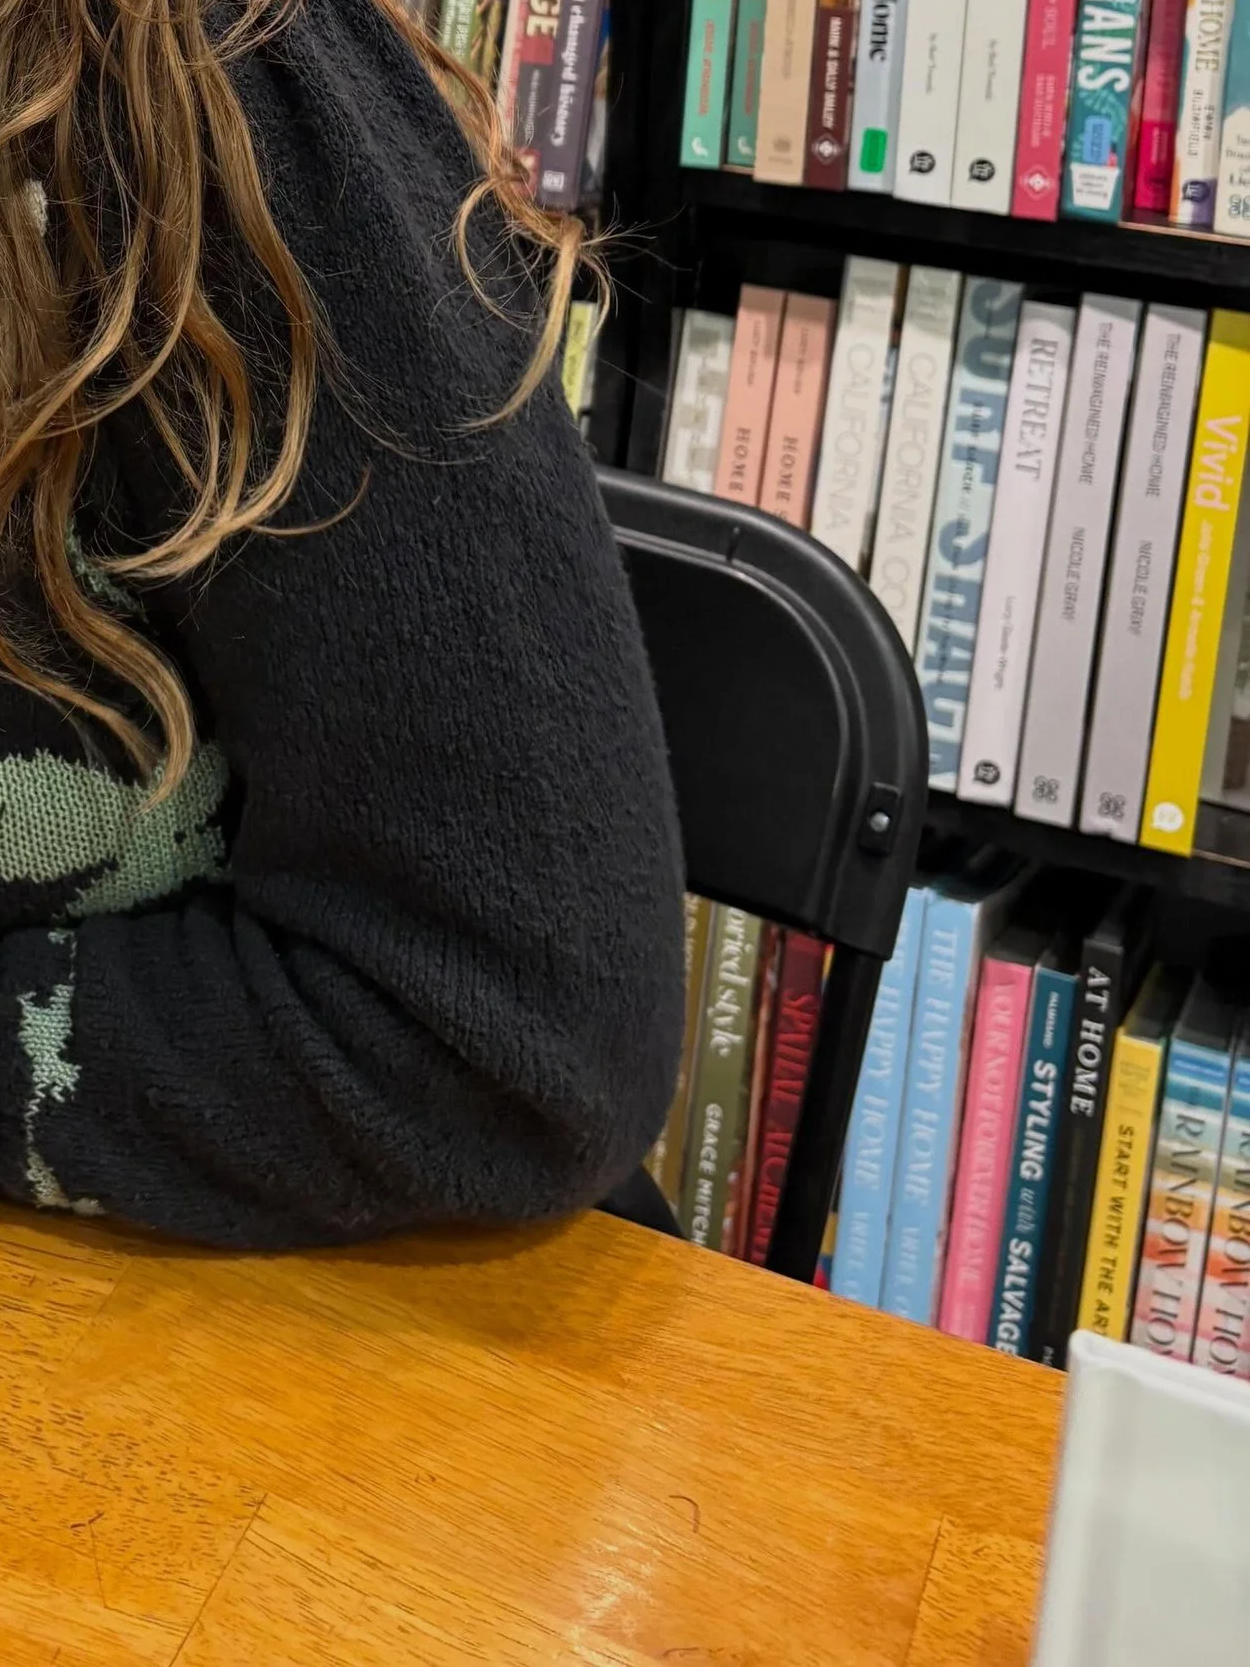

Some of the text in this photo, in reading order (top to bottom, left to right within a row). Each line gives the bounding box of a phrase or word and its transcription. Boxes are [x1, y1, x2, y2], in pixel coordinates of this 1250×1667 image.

[1194, 0, 1225, 73] HOME
[728, 427, 752, 492] HOME
[827, 342, 876, 531] CALIFORNIA
[891, 352, 938, 543] CALIFORNIA
[951, 284, 1020, 485] SURF
[1014, 337, 1060, 480] RETREAT
[1192, 415, 1243, 512] Vivid
[775, 435, 799, 502] HOME
[1062, 322, 1113, 622] THE REIMAGINED HOME NICOLE GRAY
[1127, 334, 1181, 636] THE REIMAGINED HOME NICOLE GRAY
[706, 986, 744, 1058] style
[854, 985, 900, 1190] HAPPY HOME
[905, 927, 959, 1206] THE HAPPY HOME
[1069, 966, 1110, 1117] AT HOME
[690, 1103, 723, 1247] GRACE MITCH
[995, 1059, 1058, 1357] STYLING with SALVAGE
[1097, 1123, 1135, 1295] START WITH THE
[1156, 1113, 1206, 1269] RAINBOW
